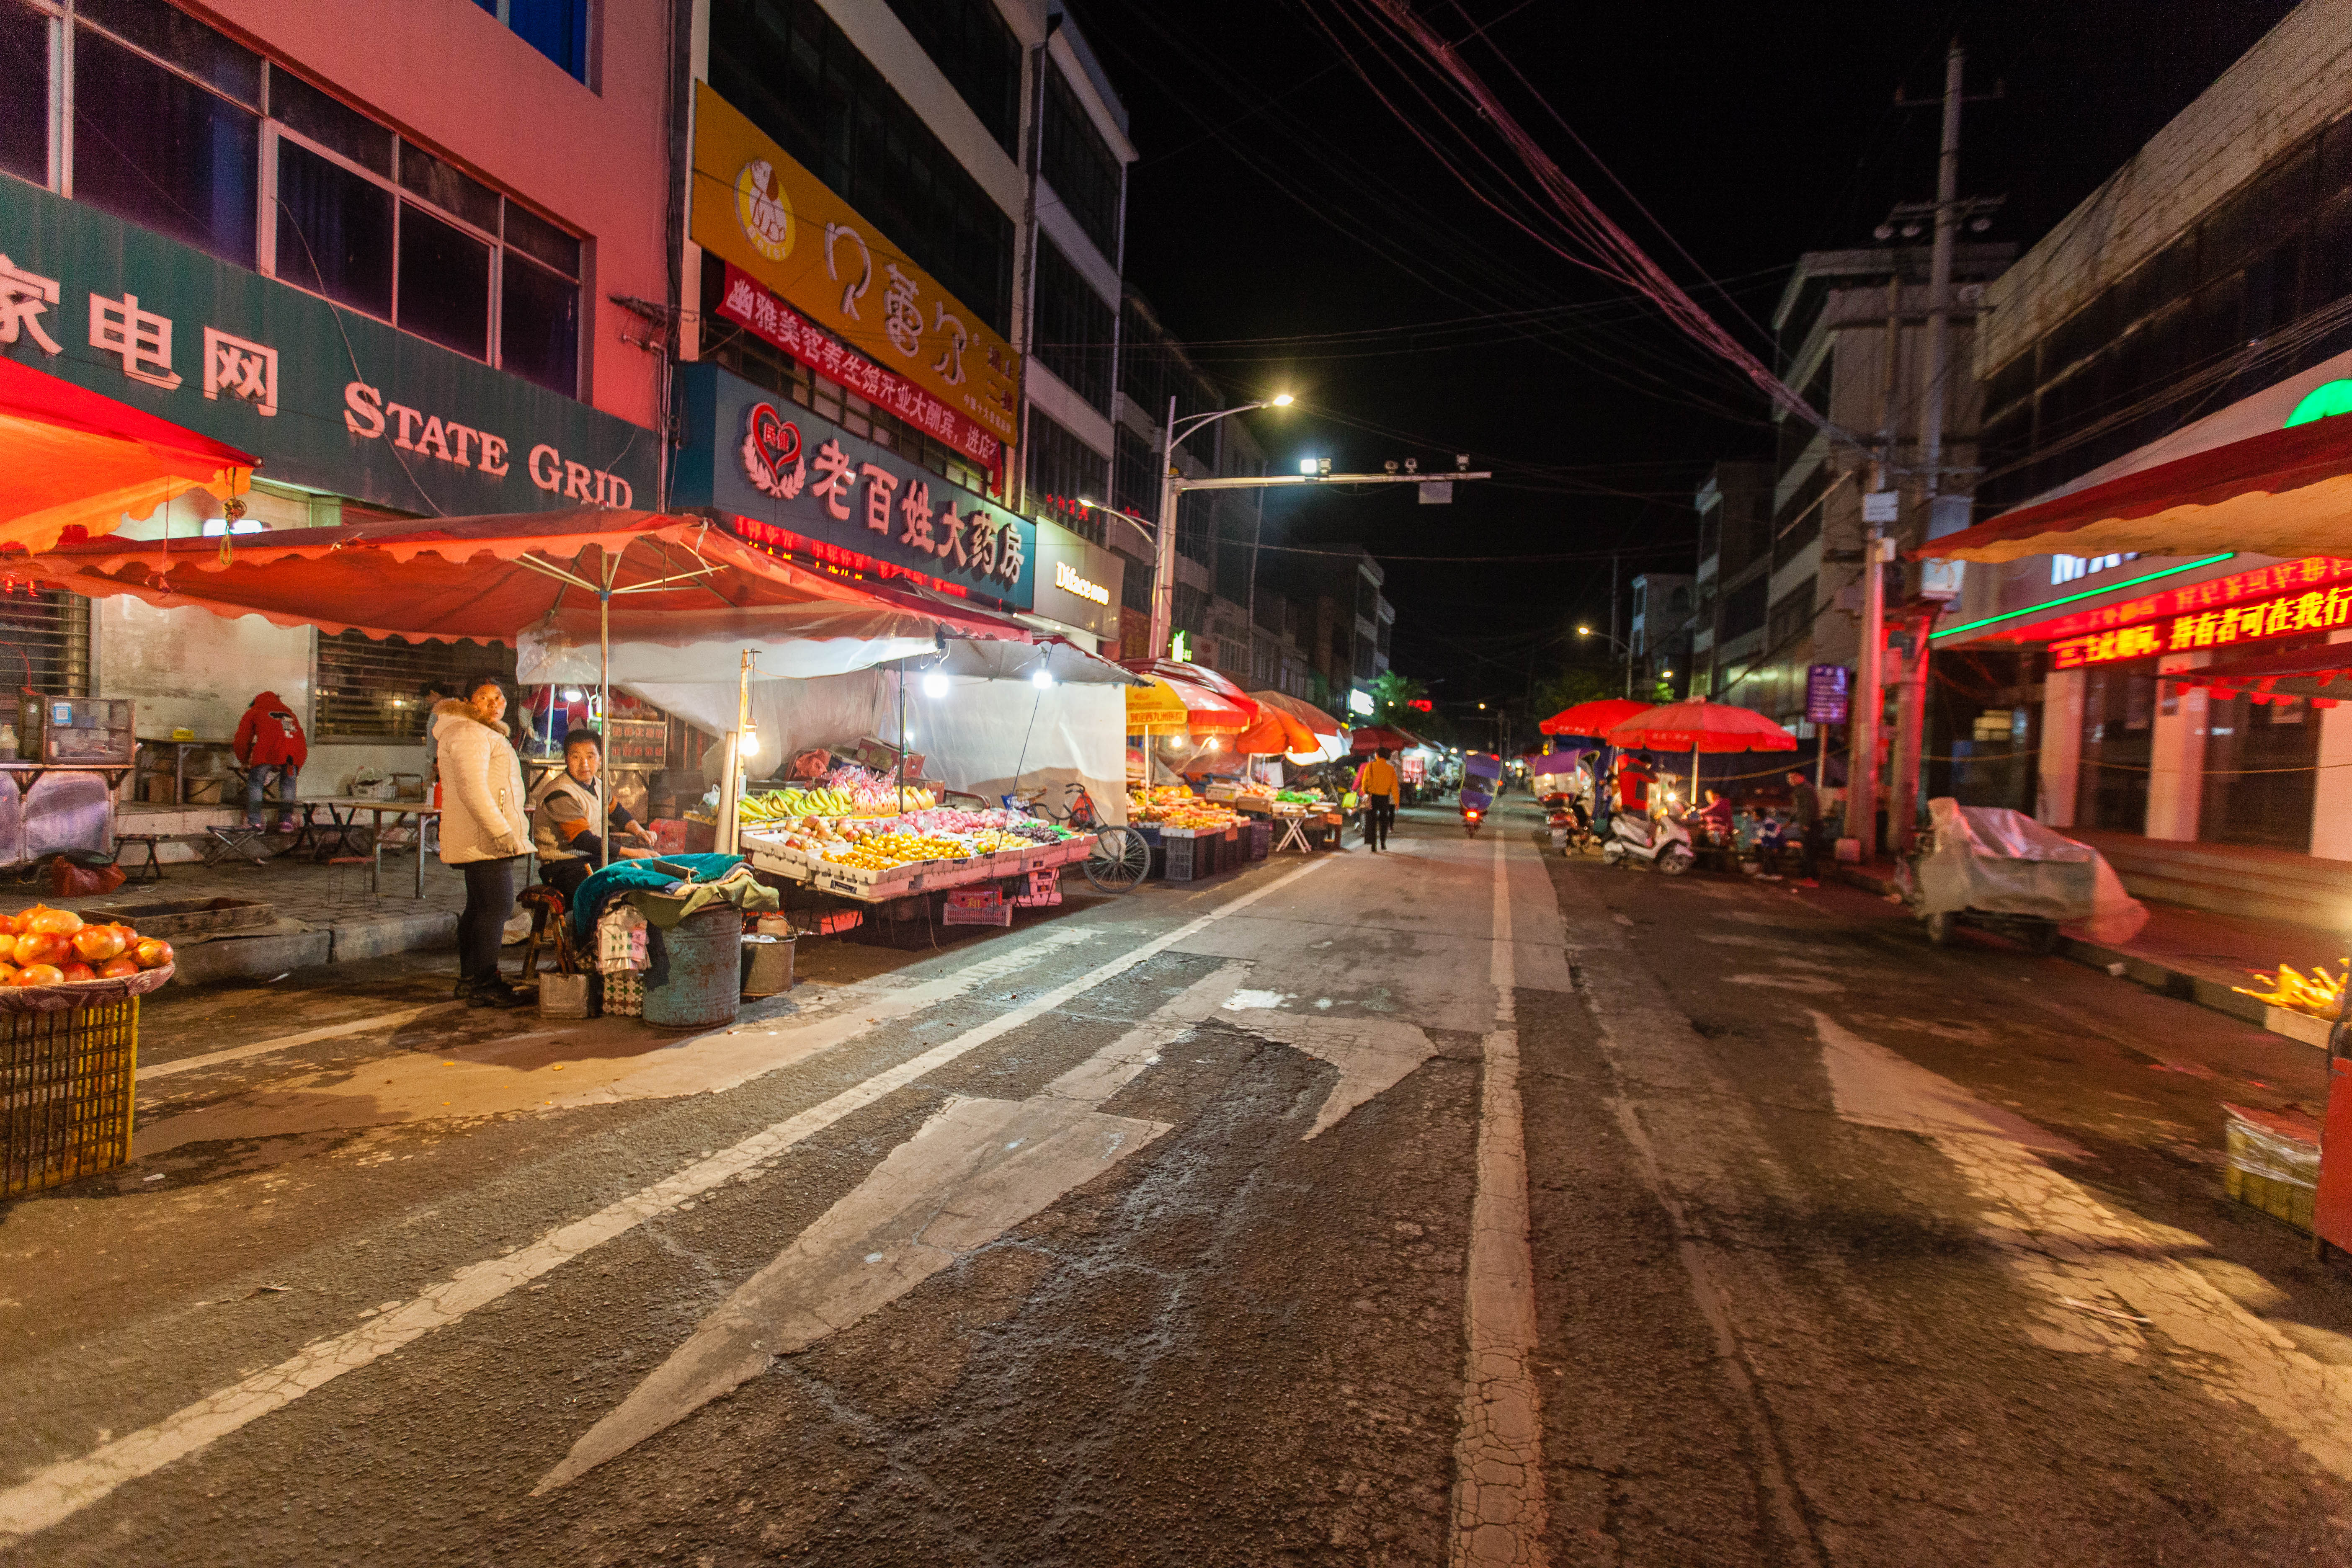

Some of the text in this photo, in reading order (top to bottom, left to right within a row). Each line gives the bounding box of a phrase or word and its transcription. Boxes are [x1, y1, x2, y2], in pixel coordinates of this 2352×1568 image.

[811, 438, 1025, 585] 老百姓大药房
